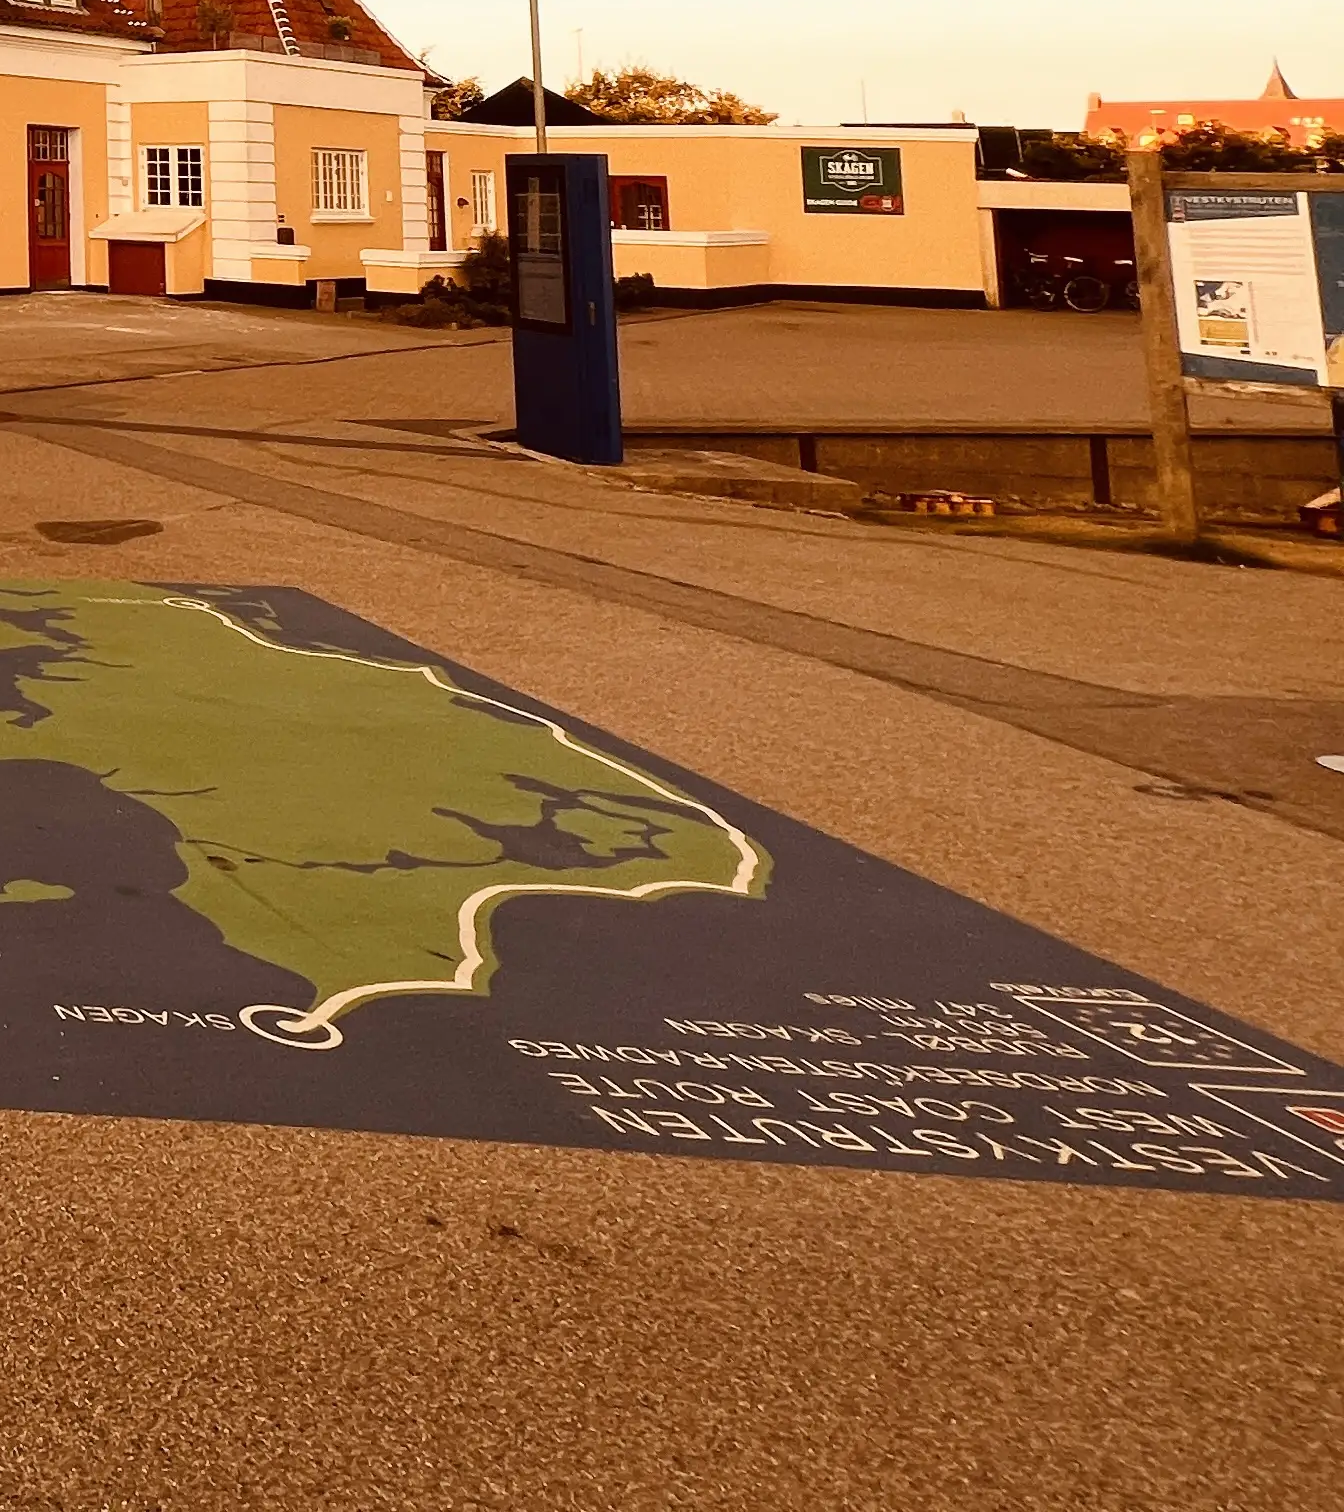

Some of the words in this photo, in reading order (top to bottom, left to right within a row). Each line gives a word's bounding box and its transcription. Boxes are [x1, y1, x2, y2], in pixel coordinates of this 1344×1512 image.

[827, 161, 875, 175] SKAGEN
[803, 992, 916, 1012] miles
[934, 1000, 1013, 1019] 347
[53, 1004, 236, 1031] SKAGEN
[664, 1017, 862, 1045] SKAGEN
[879, 1014, 958, 1034] km
[881, 1031, 1090, 1059] RUDBØL
[1109, 1021, 1197, 1045] 12
[507, 1039, 1168, 1097] NORDSEEKÜSTEN-RADWEG
[548, 1072, 775, 1108] ROUTE
[797, 1089, 1015, 1123] COAST
[1042, 1105, 1250, 1139] WEST
[591, 1105, 1330, 1182] VESTKYSTRUTEN
